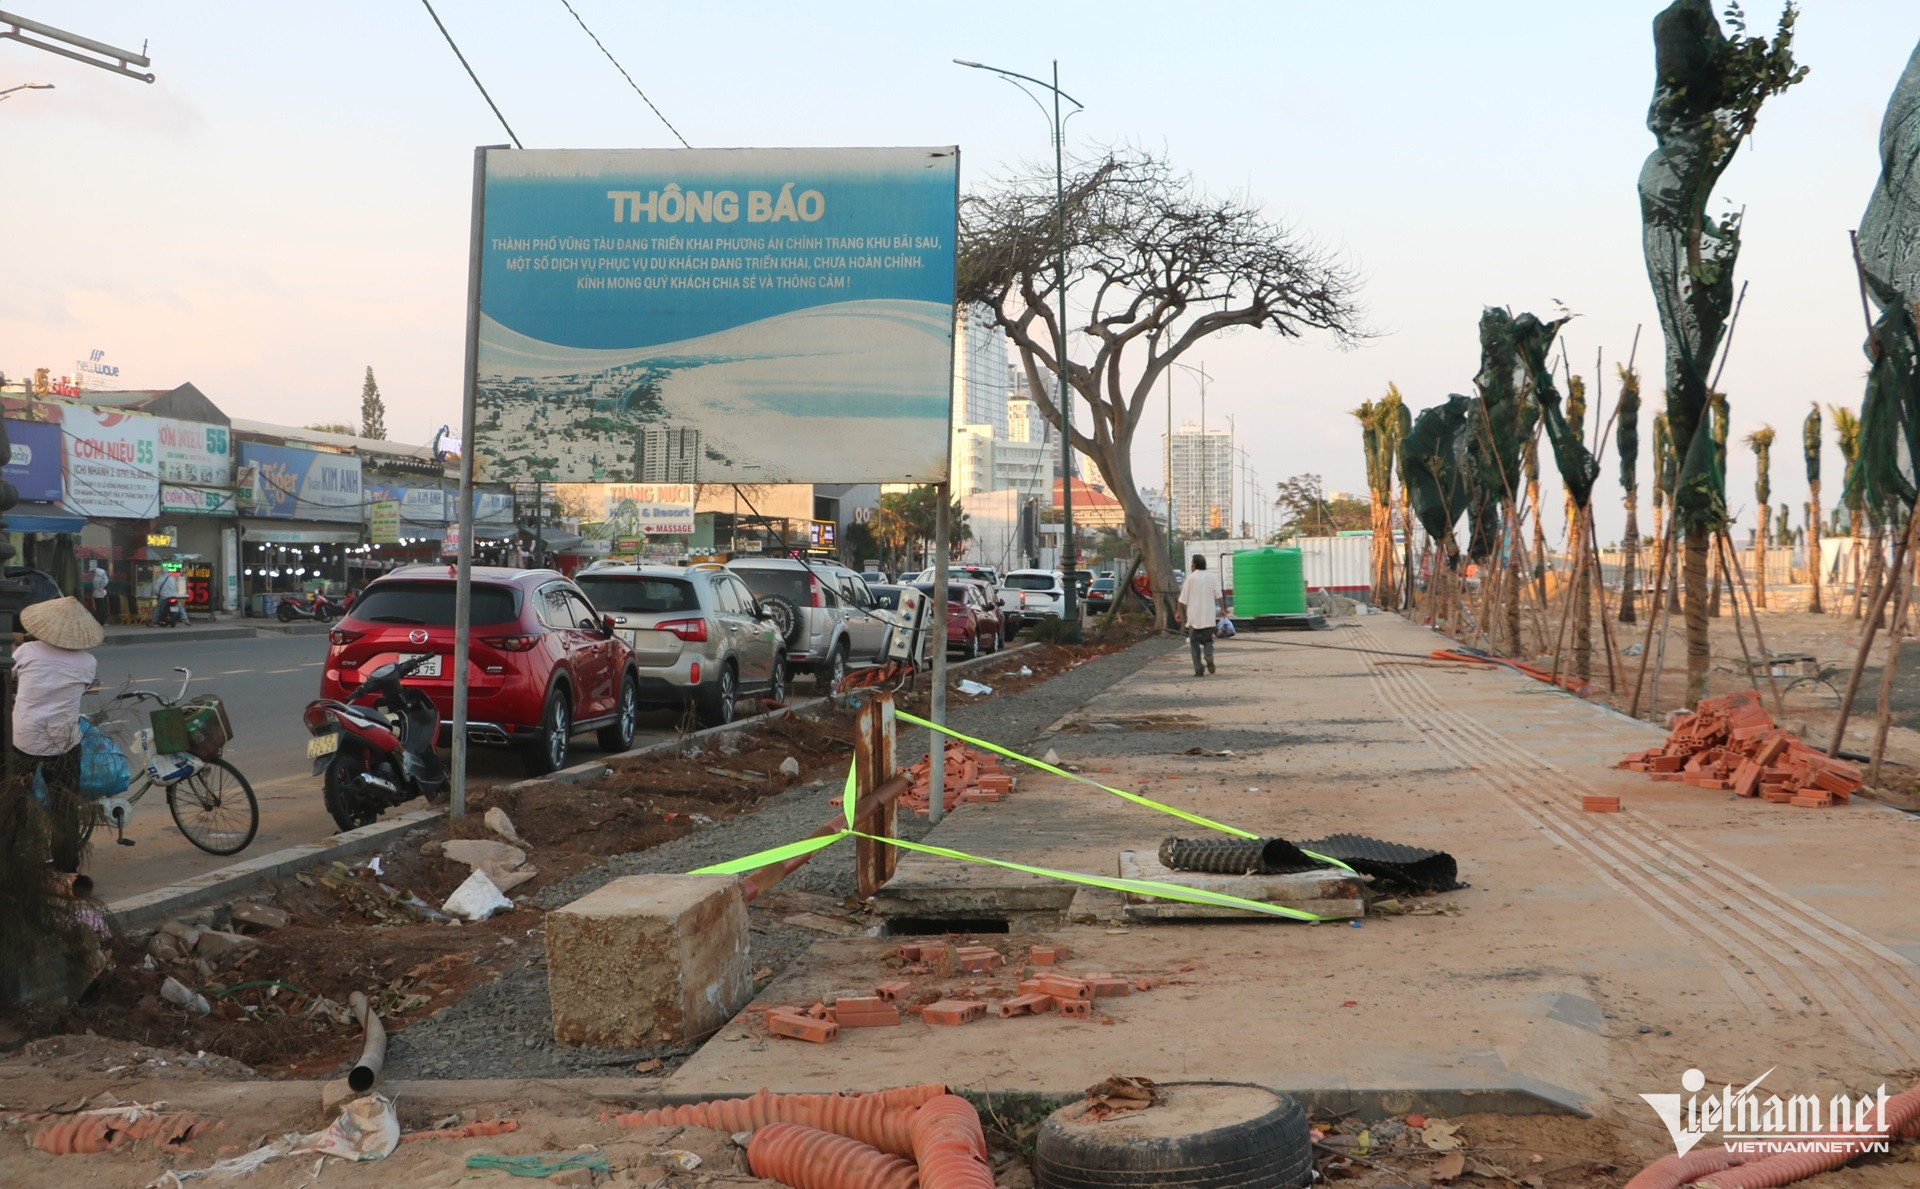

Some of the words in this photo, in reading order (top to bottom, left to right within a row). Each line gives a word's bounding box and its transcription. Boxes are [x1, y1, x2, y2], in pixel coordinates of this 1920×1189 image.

[607, 182, 739, 223] THÔNG
[747, 182, 825, 222] BÁO
[491, 235, 530, 250] THÀNH
[533, 234, 557, 250] PHỐ
[559, 235, 590, 250] VŨNG
[593, 235, 614, 250] TÀU
[616, 238, 648, 250] ĐANG
[651, 234, 684, 250] TRIỂN
[686, 238, 713, 250] KHAI
[716, 237, 765, 250] PHƯƠNG
[767, 235, 784, 250] ÁN
[825, 237, 864, 250] TRANG
[866, 237, 891, 248] KHU
[893, 234, 912, 248] BÃI
[914, 236, 942, 250] SAU,
[506, 255, 532, 272] MỘT
[534, 254, 549, 270] SỐ
[551, 258, 578, 272] DỊCH
[580, 258, 596, 272] VỤ
[599, 258, 630, 272] PHỤC
[632, 258, 648, 272] VỤ
[650, 258, 666, 270] DU
[668, 254, 708, 270] KHÁCH
[710, 258, 742, 270] ĐANG
[745, 254, 778, 269] TRIỂN
[780, 257, 811, 270] KHAI,
[814, 256, 846, 268] CHƯA
[849, 254, 882, 268] HOÀN
[578, 274, 604, 289] KÍNH
[608, 277, 642, 289] MONG
[644, 274, 669, 290] QUÝ
[671, 274, 710, 288] KHÁCH
[712, 276, 740, 288] CHIA
[759, 274, 774, 288] VÀ
[776, 274, 816, 288] THÔNG
[206, 428, 227, 454] 55
[137, 439, 154, 464] 55
[262, 462, 298, 504] Tiger
[322, 467, 338, 491] KIM
[340, 469, 358, 494] ANH
[206, 492, 220, 506] 55
[238, 488, 252, 498] 55
[642, 508, 650, 517] &
[653, 508, 690, 517] Resort
[656, 524, 692, 532] MASSAGE
[186, 582, 209, 603] 55
